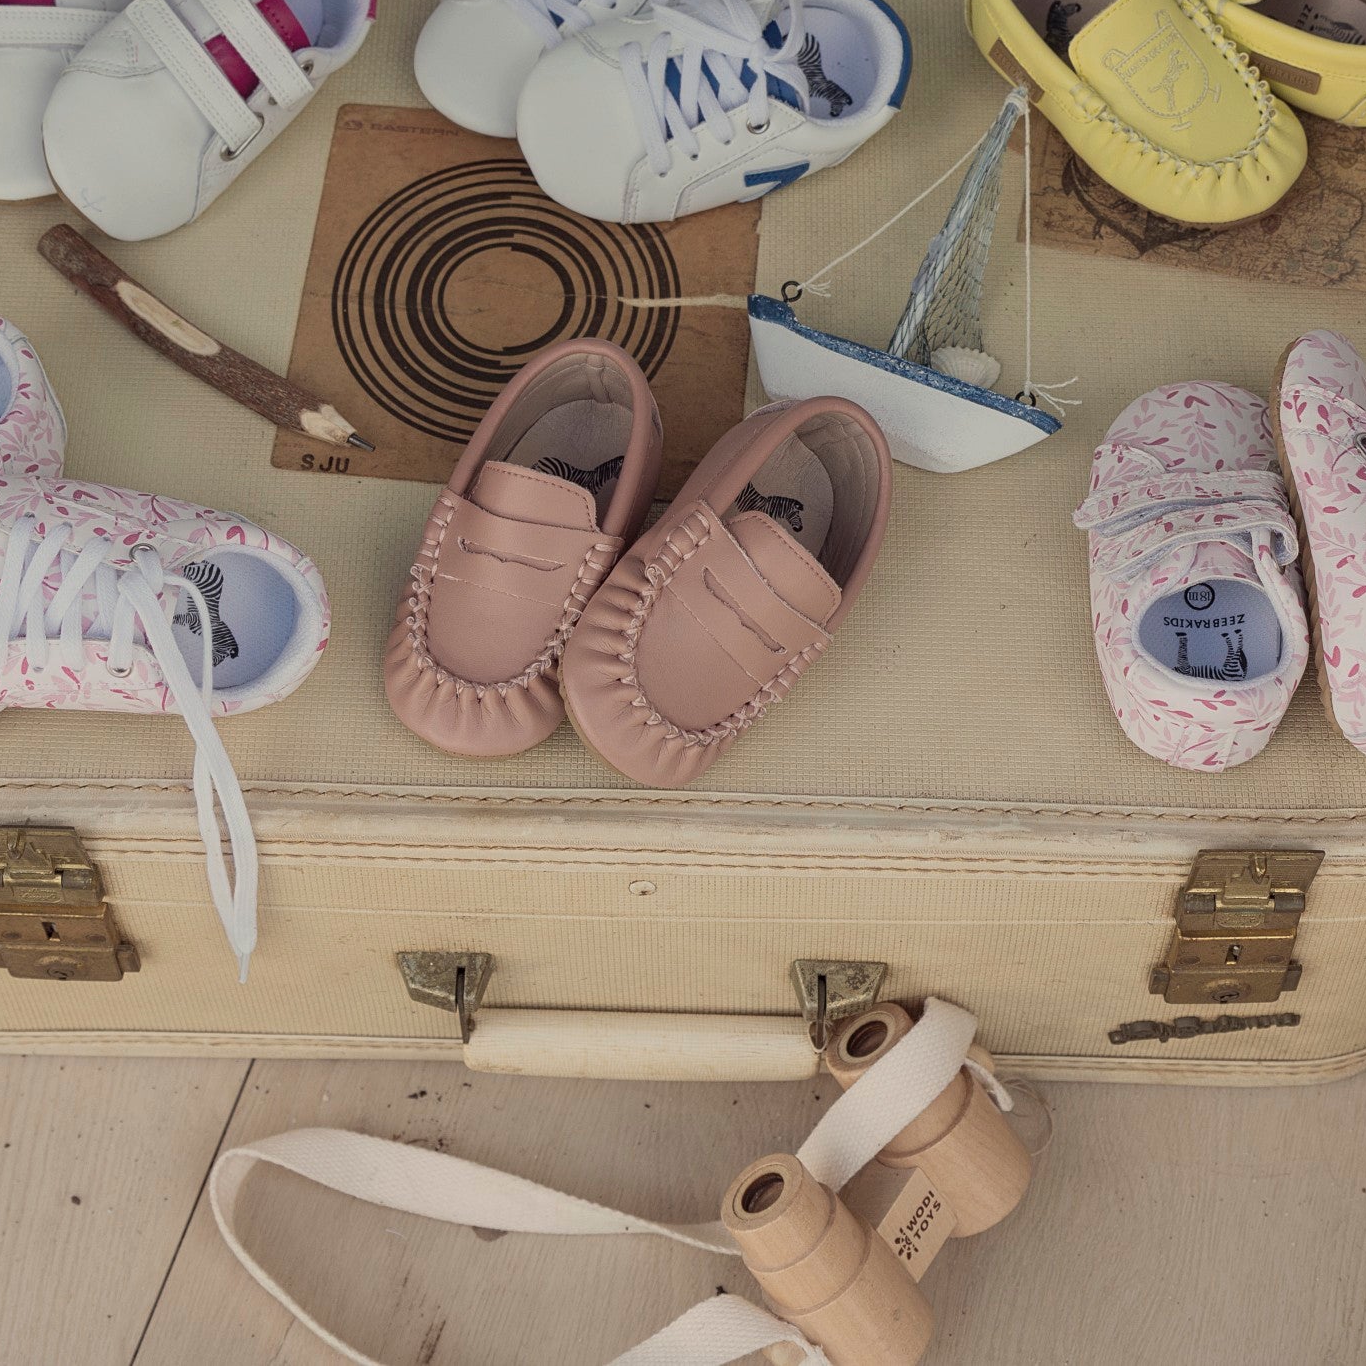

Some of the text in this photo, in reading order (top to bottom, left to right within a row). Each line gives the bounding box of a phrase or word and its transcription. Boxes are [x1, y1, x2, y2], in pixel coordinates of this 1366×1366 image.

[1163, 614, 1246, 629] ZEEBRAKIDS
[906, 1190, 935, 1232] WODI
[914, 1200, 941, 1240] TOYS
